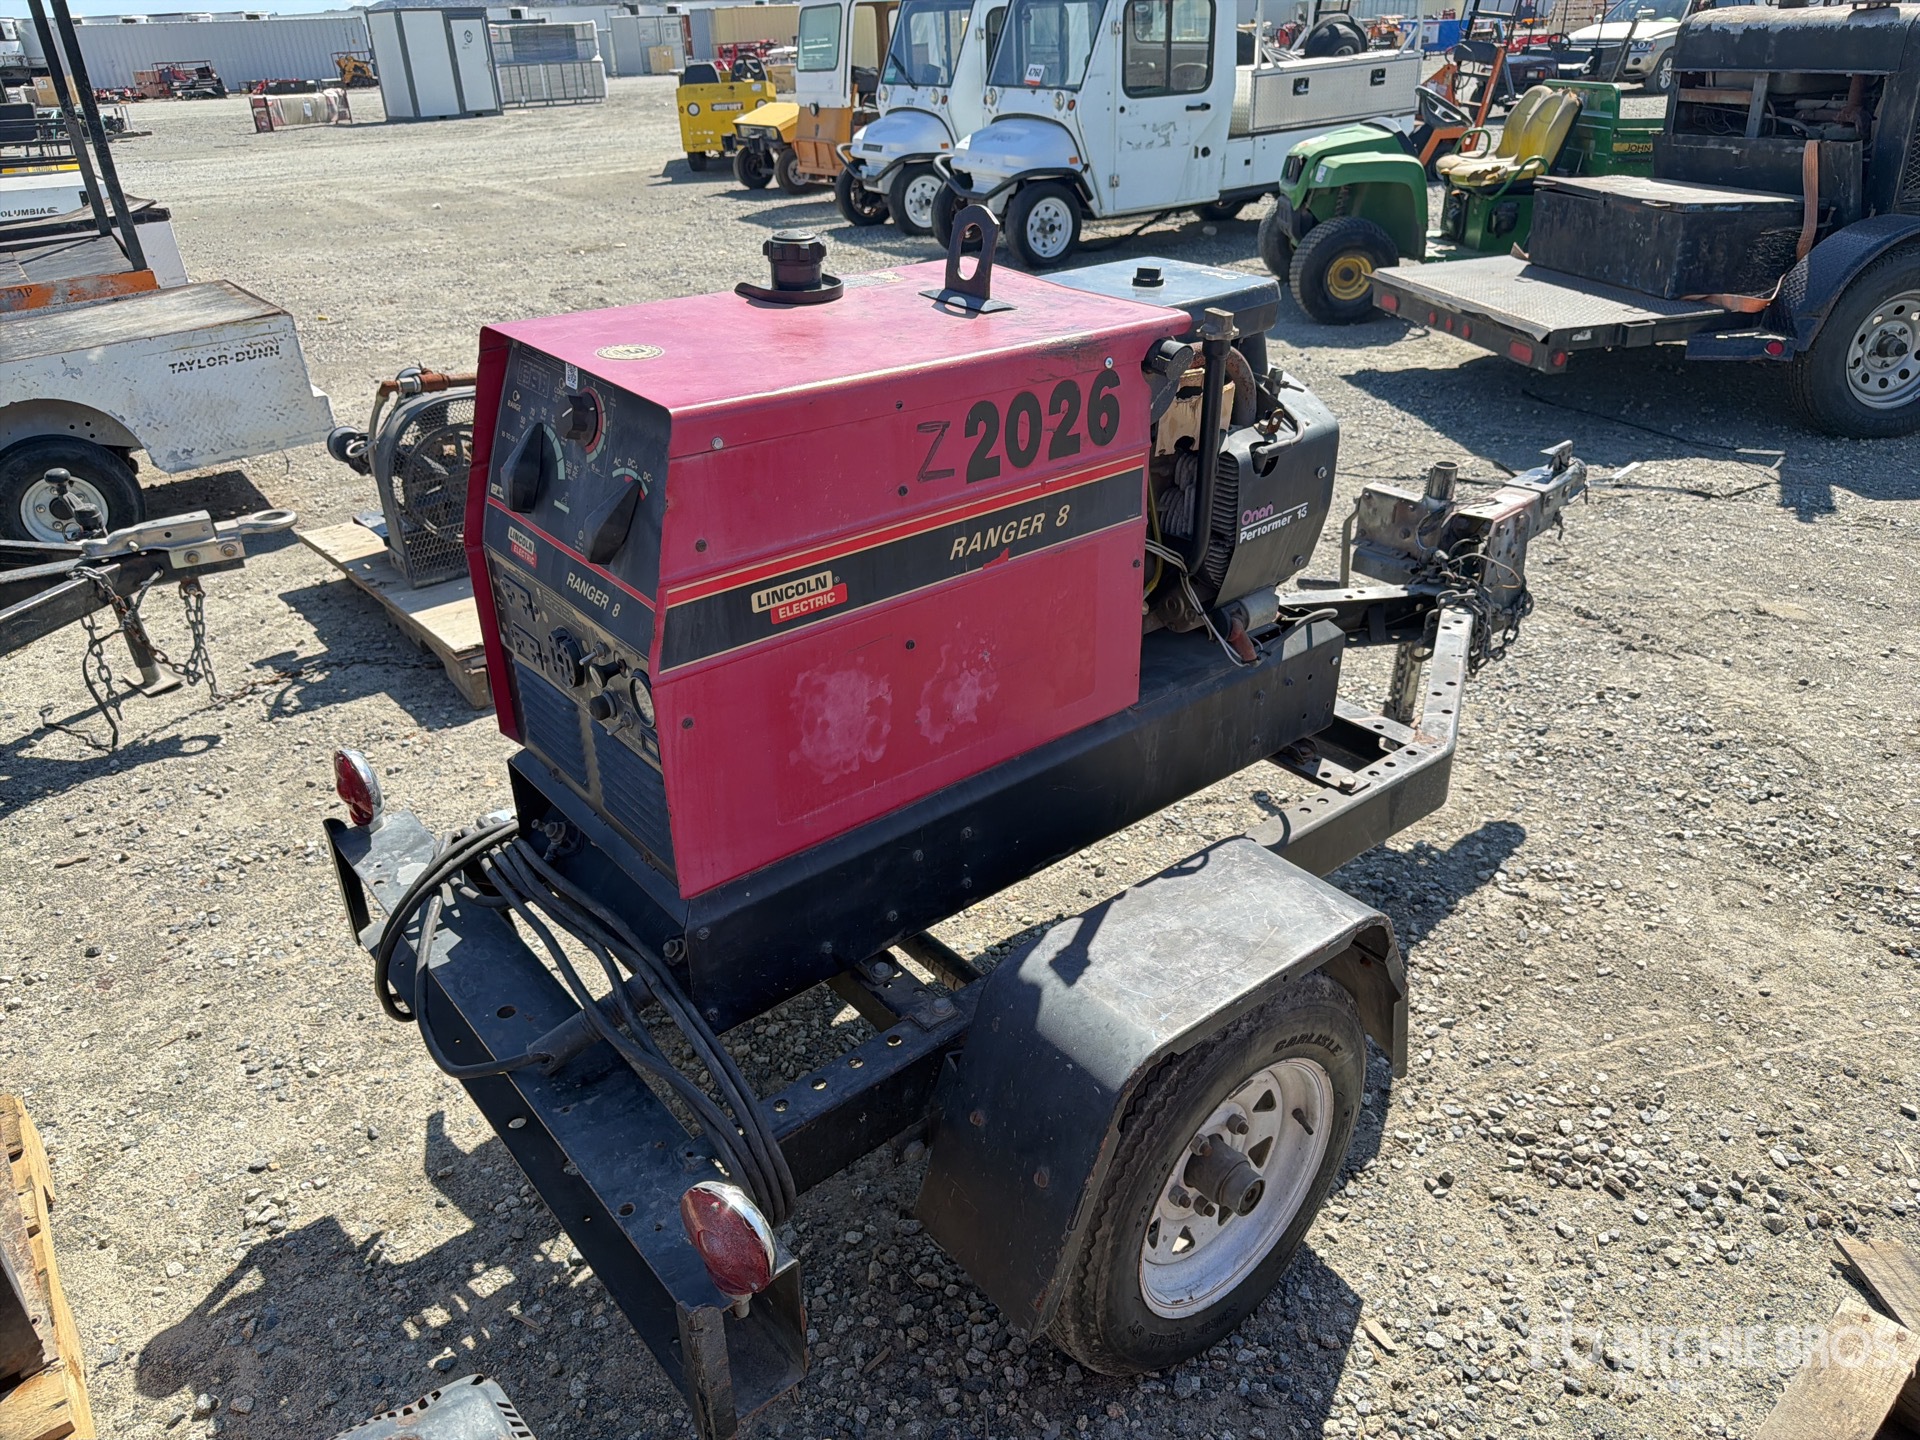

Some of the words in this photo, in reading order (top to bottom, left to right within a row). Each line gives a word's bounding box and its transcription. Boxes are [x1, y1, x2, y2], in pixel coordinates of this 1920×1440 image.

[1625, 143, 1652, 152] JOHN
[0, 207, 46, 218] OLUMBIA
[168, 344, 280, 375] TAYLOR-DUNN
[964, 369, 1121, 485] 2026
[509, 527, 534, 553] LINCOLN
[949, 511, 1047, 561] RANGER
[1055, 504, 1071, 527] 8
[1239, 514, 1293, 544] Performer
[513, 545, 536, 566] ELECTRIC
[566, 571, 610, 611] RANGER
[611, 603, 621, 617] 8
[757, 574, 828, 609] LINCOLN
[778, 592, 836, 619] ELECTRIC
[1272, 1032, 1343, 1057] CARLISLE
